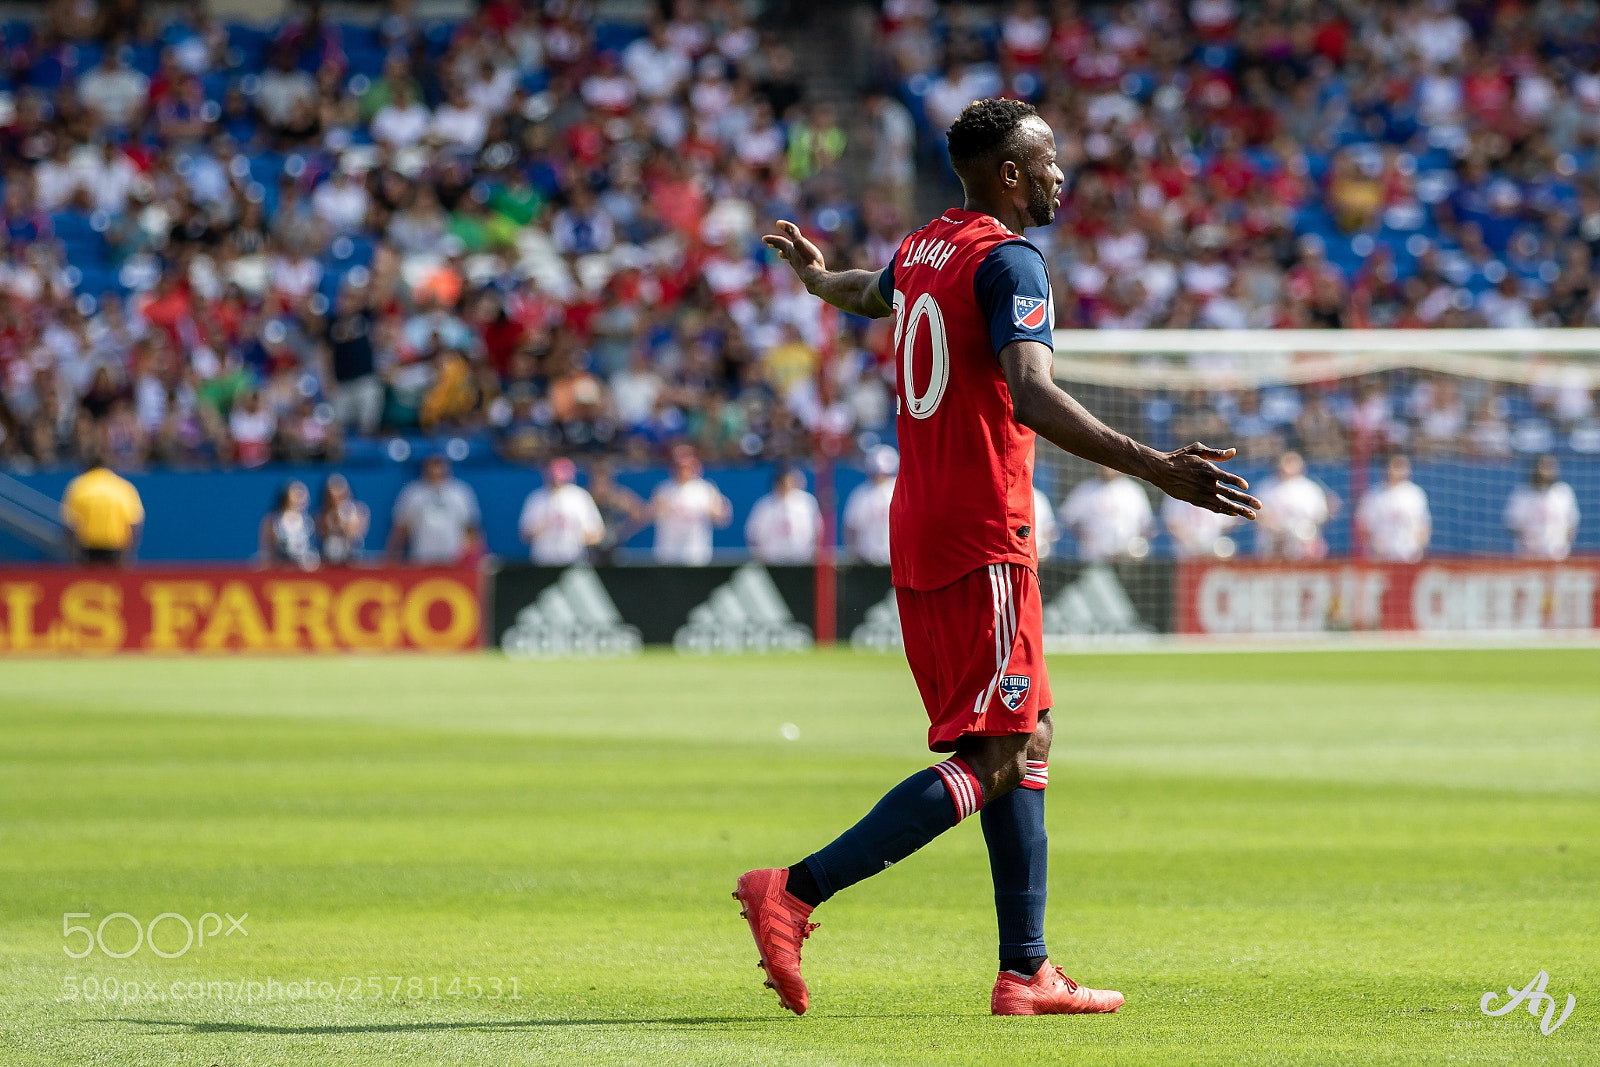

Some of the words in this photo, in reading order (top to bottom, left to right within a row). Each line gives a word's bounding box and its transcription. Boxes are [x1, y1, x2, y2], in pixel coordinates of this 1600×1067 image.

[1017, 299, 1034, 308] MLS
[0, 580, 125, 650] LS
[142, 580, 479, 652] FARGO
